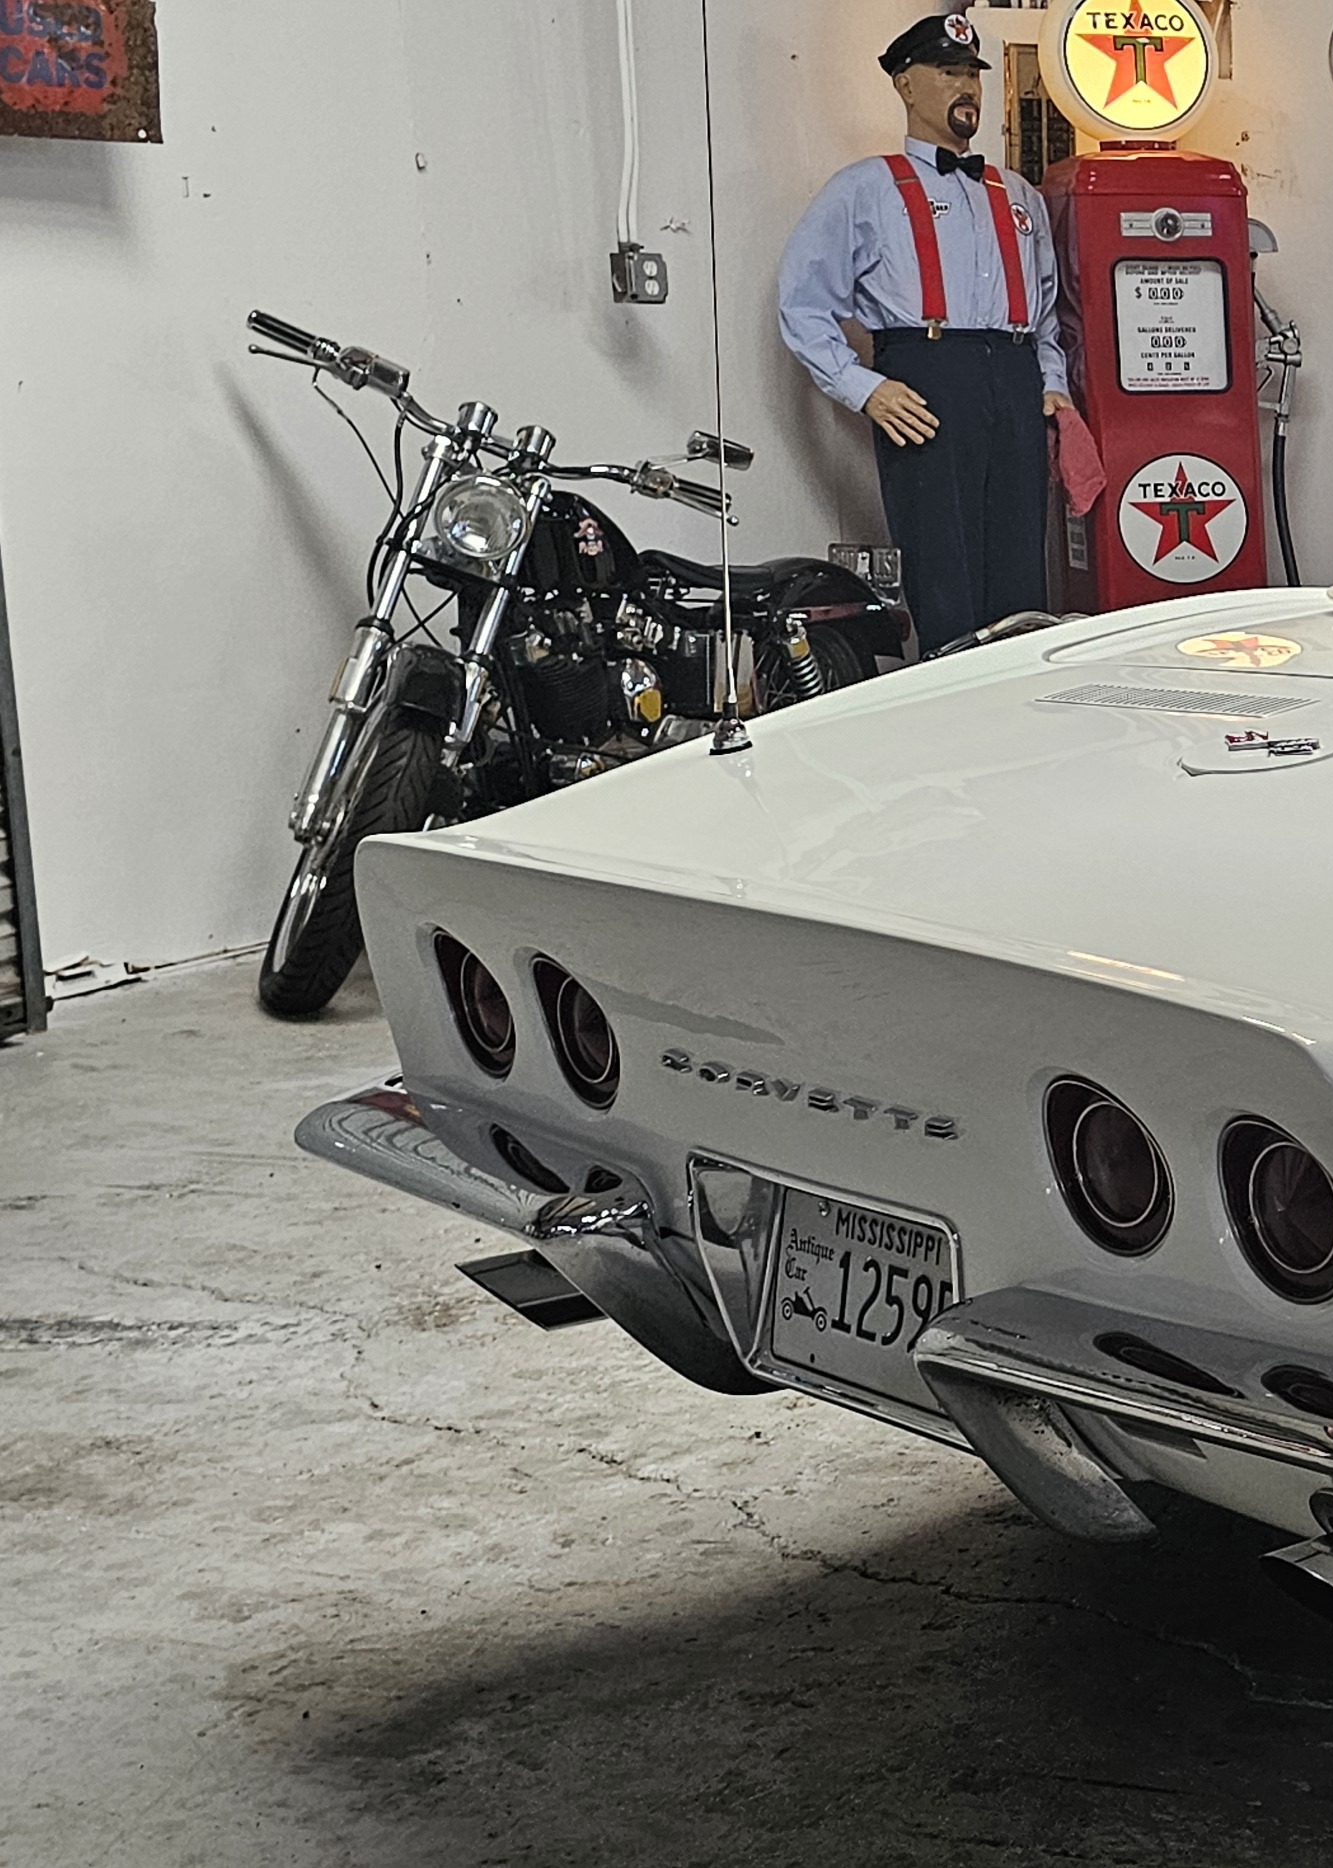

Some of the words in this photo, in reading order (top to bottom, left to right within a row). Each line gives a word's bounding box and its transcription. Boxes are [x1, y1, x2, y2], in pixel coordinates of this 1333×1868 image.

[1086, 12, 1184, 31] TEXACO
[1138, 482, 1226, 499] TEXACO
[660, 1047, 960, 1141] CORVETTE
[786, 1228, 835, 1264] Antique
[836, 1207, 943, 1266] MISSISSIPPI
[785, 1257, 808, 1281] Car
